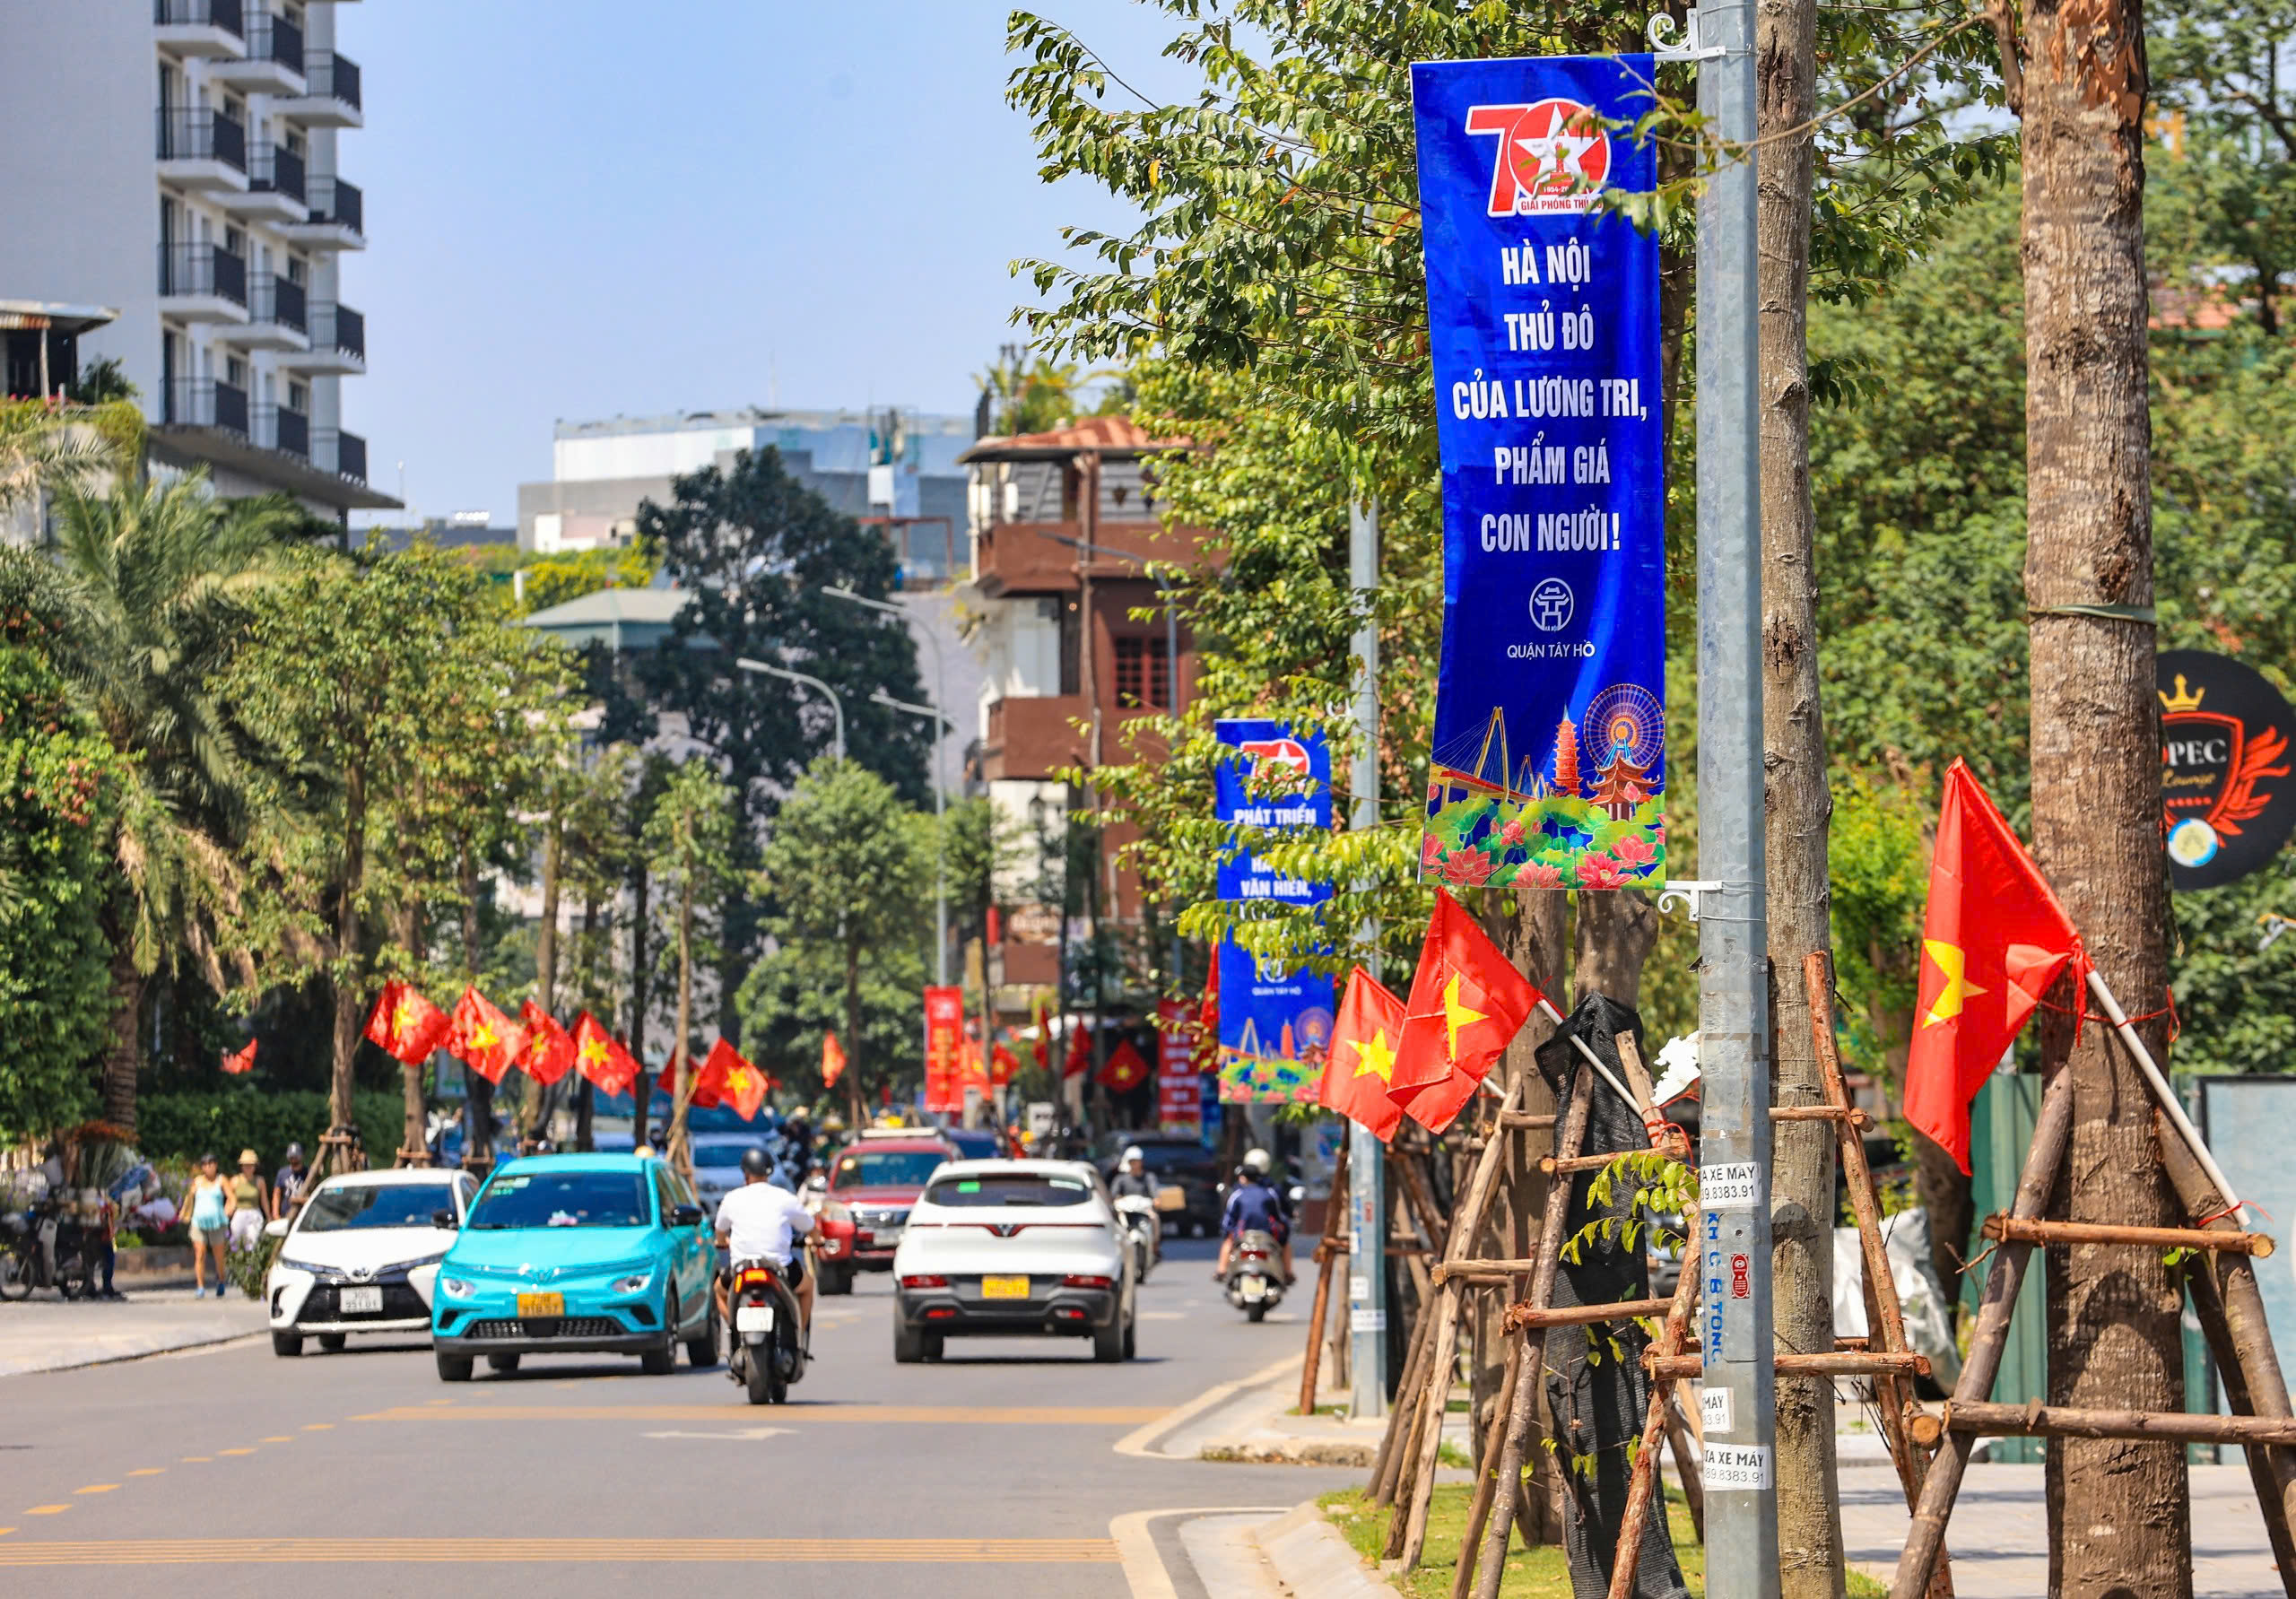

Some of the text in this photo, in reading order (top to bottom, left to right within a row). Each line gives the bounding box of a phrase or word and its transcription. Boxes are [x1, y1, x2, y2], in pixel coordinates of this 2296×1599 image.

[1500, 236, 1591, 291] HÀ NỘI
[1503, 299, 1594, 352] THỦ ĐÔ
[1452, 368, 1648, 421] CỦA LƯƠNG TRI,
[1494, 430, 1611, 485] PHẨM GIÁ
[1481, 503, 1622, 552] CON NGƯỜI!
[1507, 639, 1596, 661] QUẬN TÂY HỒ
[2163, 738, 2228, 767] PEC
[1710, 1168, 1723, 1181] XE
[1718, 1451, 1732, 1465] XE
[1736, 1450, 1764, 1468] MÁY
